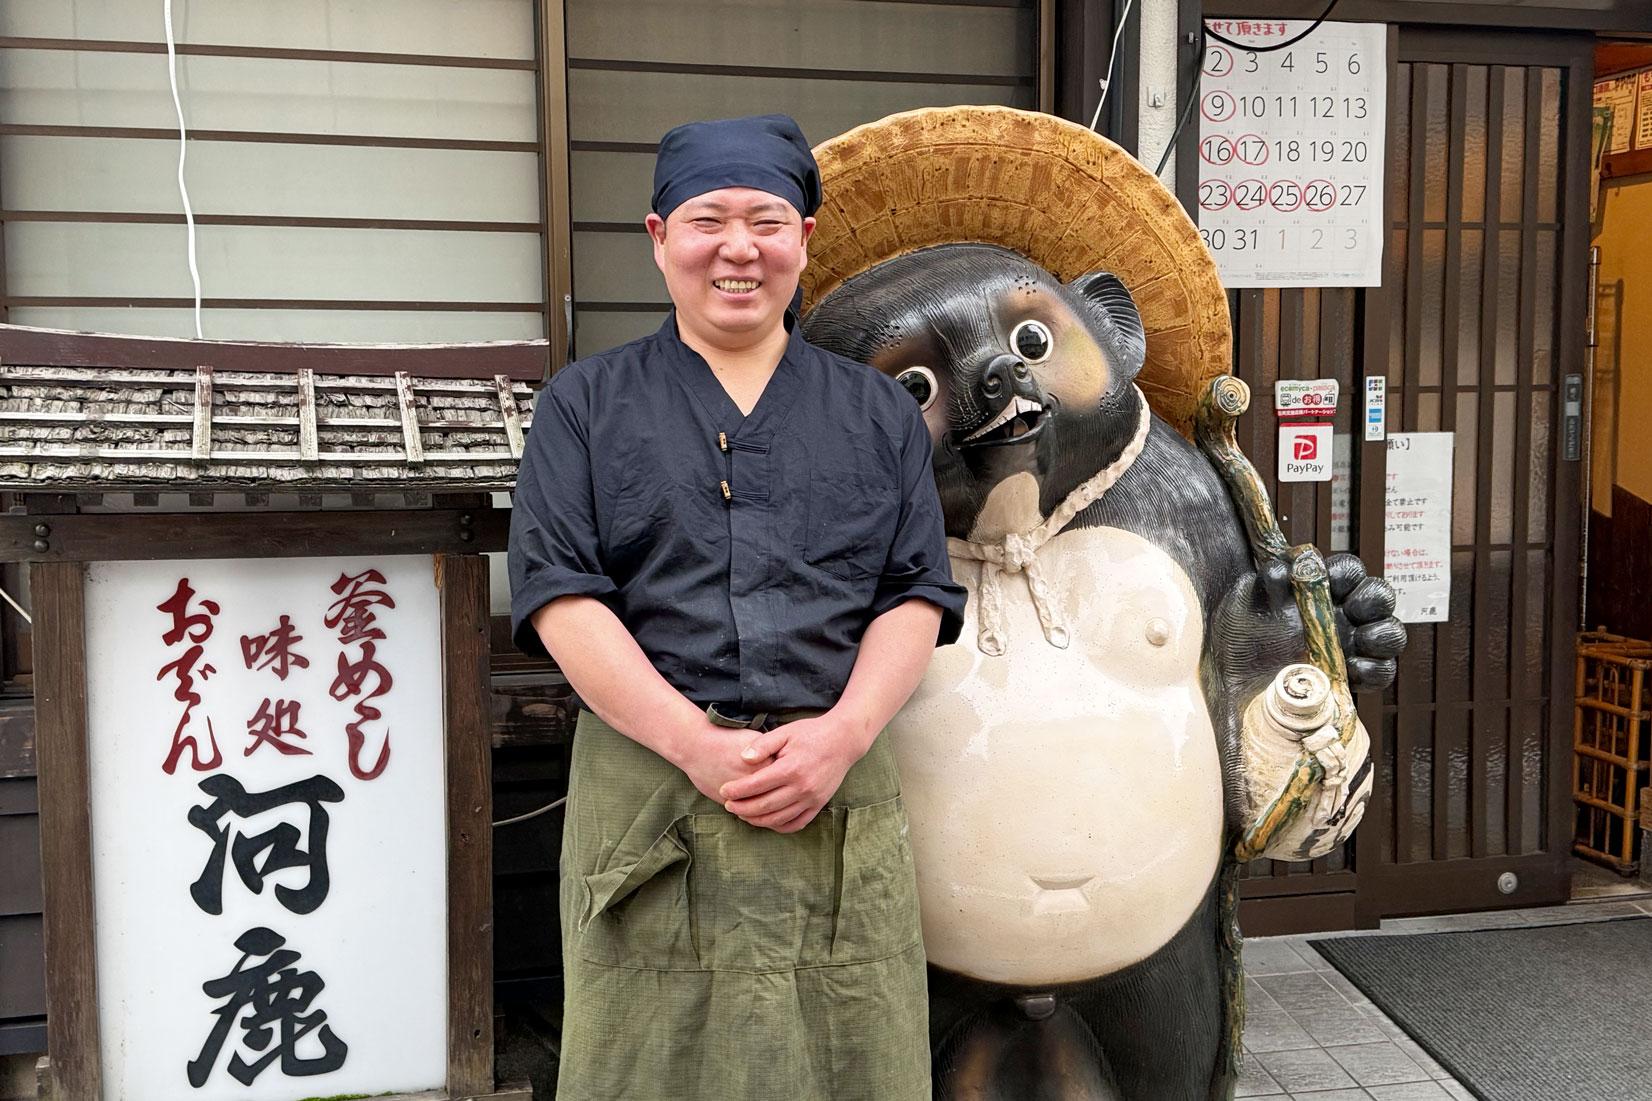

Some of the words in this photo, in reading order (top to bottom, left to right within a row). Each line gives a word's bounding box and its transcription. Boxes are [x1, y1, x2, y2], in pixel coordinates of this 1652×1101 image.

[1210, 50, 1224, 72] 2
[1245, 51, 1259, 73] 3
[1280, 52, 1295, 73] 4
[1315, 52, 1329, 74] 5
[1348, 53, 1361, 75] 6
[1212, 95, 1225, 117] 9
[1240, 96, 1266, 118] 10
[1275, 96, 1297, 118] 11
[1310, 96, 1335, 118] 12
[1343, 97, 1367, 119] 13
[1204, 140, 1232, 163] 16
[1240, 140, 1266, 162] 17
[1275, 140, 1300, 162] 18
[1310, 141, 1335, 163] 19
[1341, 141, 1367, 163] 20
[1200, 184, 1228, 206] 23
[1236, 184, 1264, 206] 24
[1271, 185, 1299, 207] 25
[1306, 185, 1333, 207] 26
[1340, 185, 1367, 207] 27
[1199, 228, 1226, 250] 30
[1232, 228, 1257, 250] 31
[1278, 228, 1287, 250] 1
[1311, 228, 1324, 250] 2
[1344, 229, 1358, 250] 3
[1287, 463, 1324, 474] PayPay
[1385, 523, 1425, 532] み可能です
[156, 577, 222, 776] おでん
[241, 615, 313, 757] 味処
[324, 569, 396, 781] 釜めし
[187, 773, 348, 1088] 河鹿
